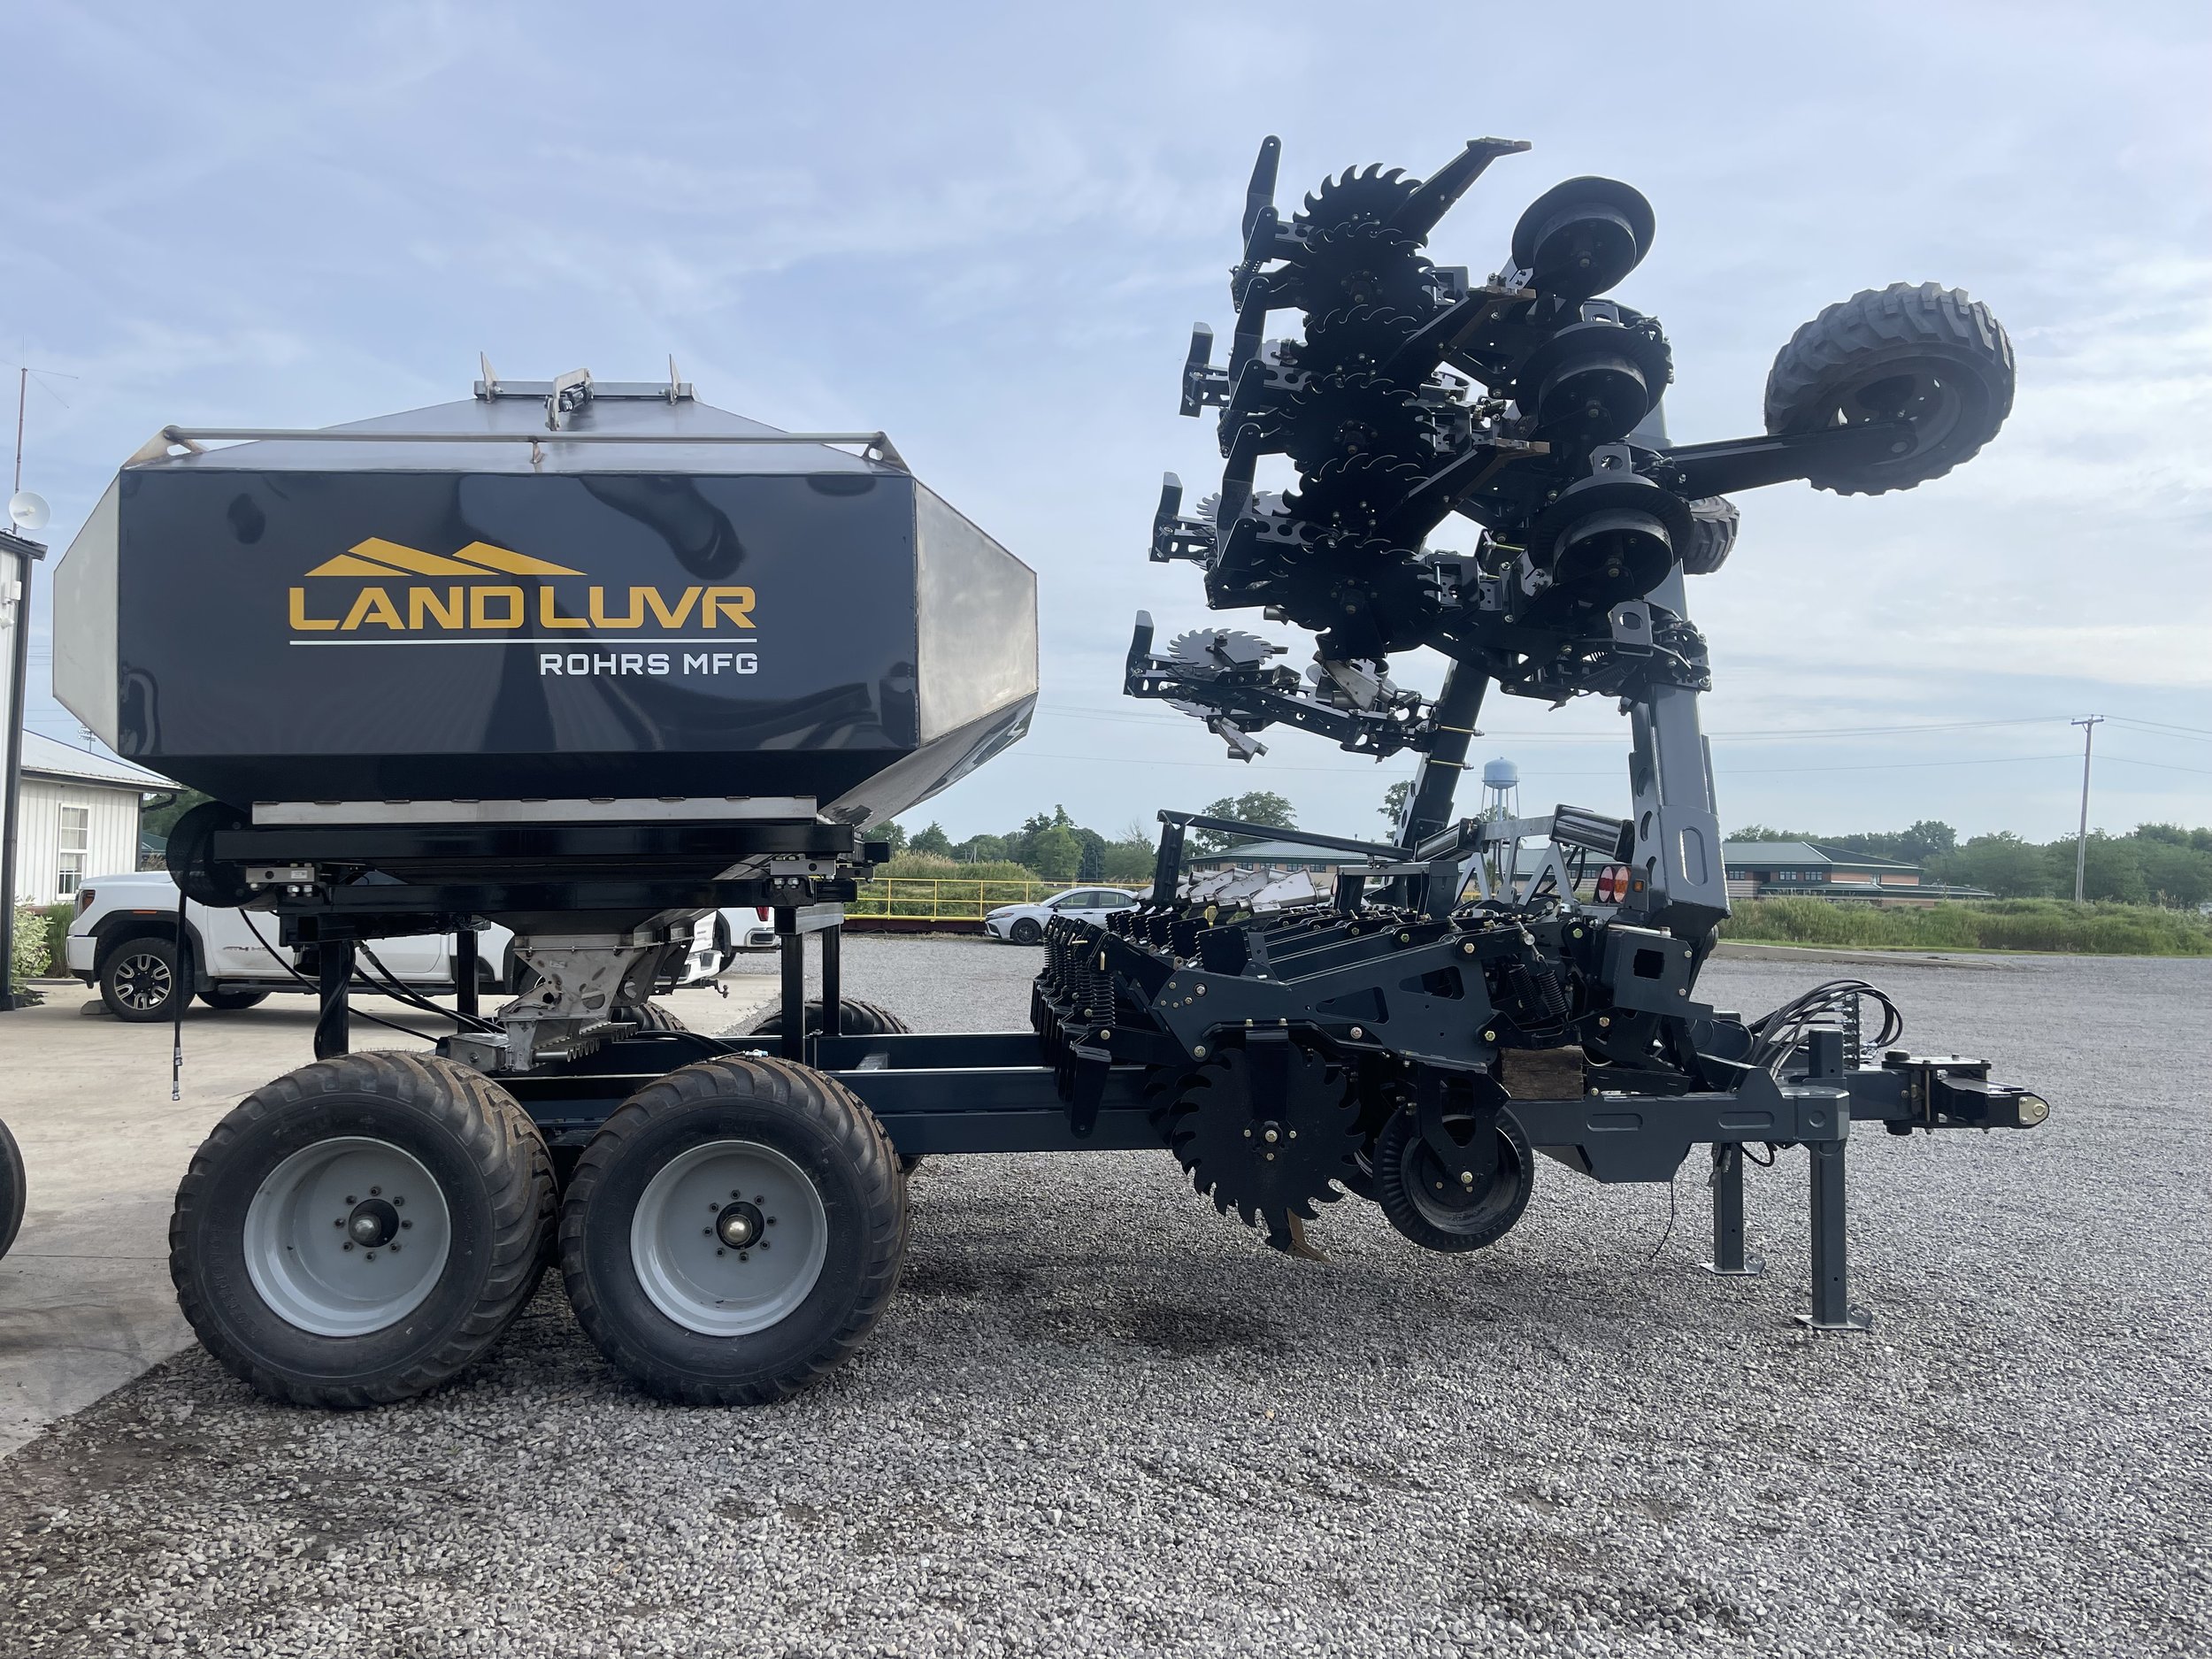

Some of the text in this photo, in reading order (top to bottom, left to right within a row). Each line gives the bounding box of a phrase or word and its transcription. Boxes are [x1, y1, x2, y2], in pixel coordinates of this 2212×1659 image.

[288, 586, 757, 630] LAND LUVR
[540, 653, 758, 675] ROHRS MFG
